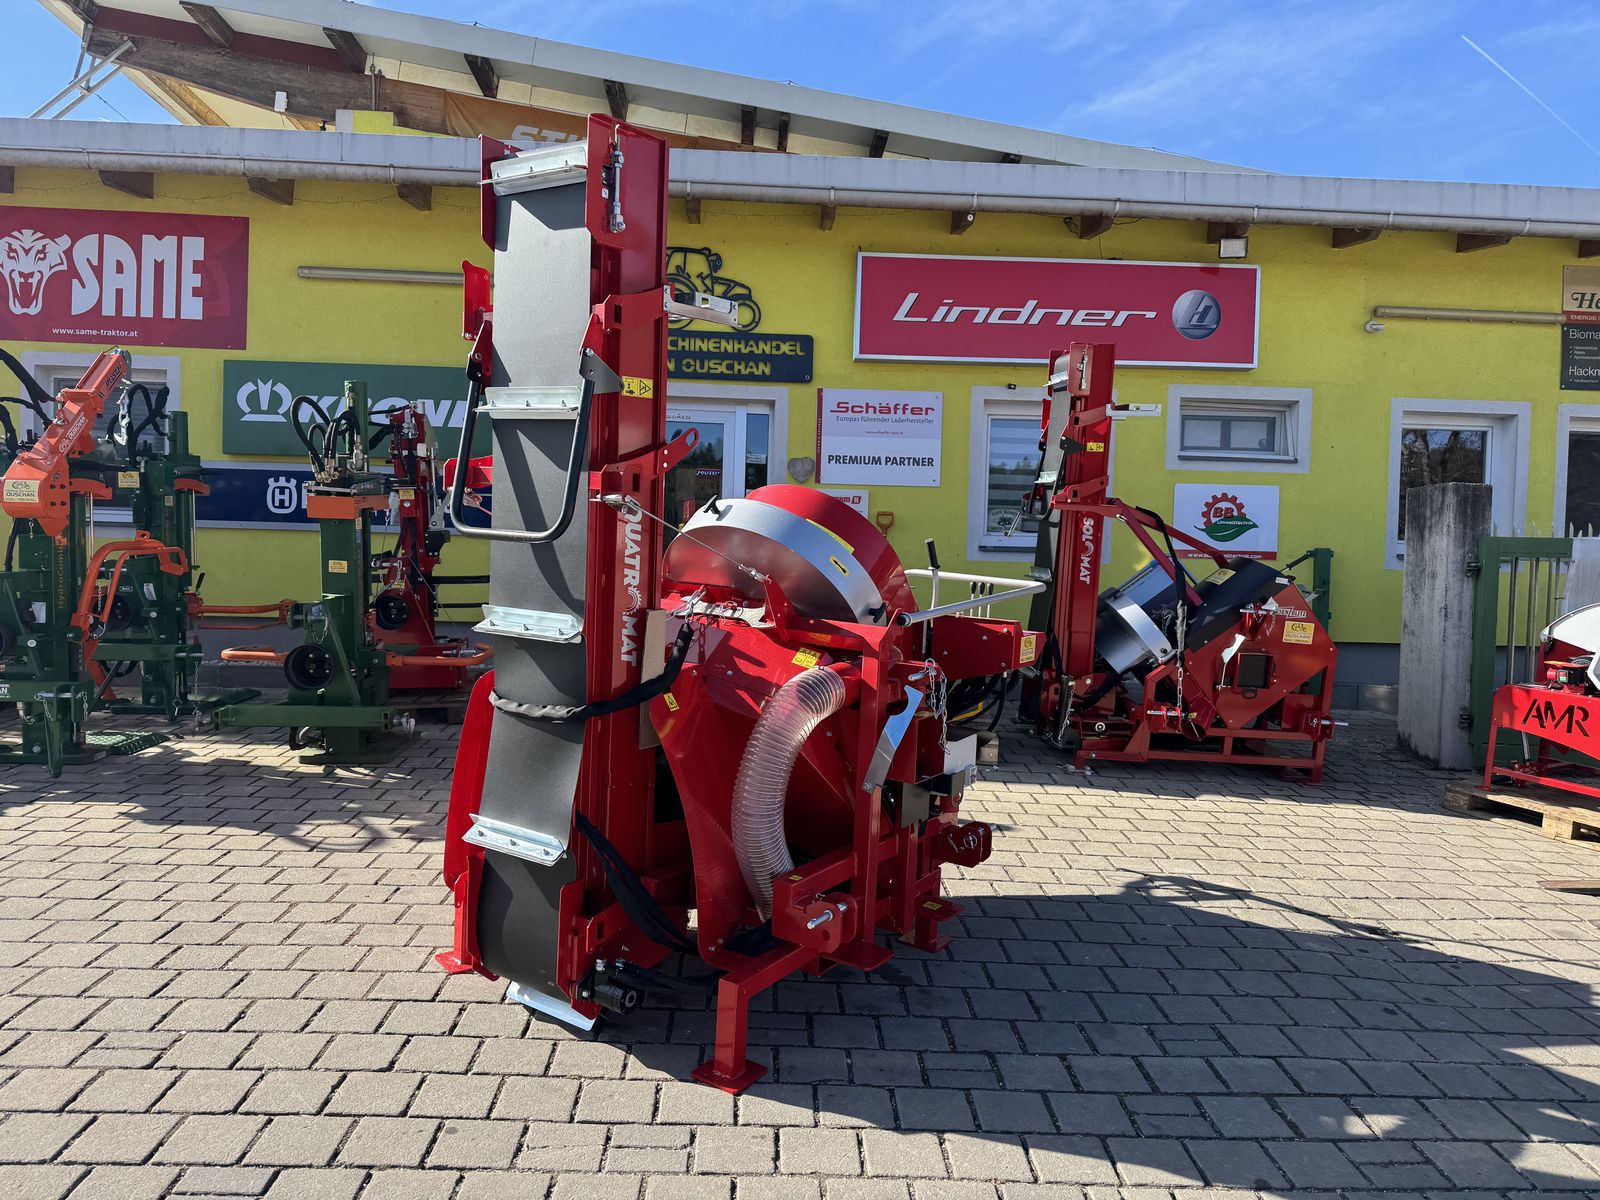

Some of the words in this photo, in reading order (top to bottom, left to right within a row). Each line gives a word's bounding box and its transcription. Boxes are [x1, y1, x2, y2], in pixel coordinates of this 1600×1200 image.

[71, 233, 205, 320] SAME
[892, 292, 1158, 328] Lindner
[52, 327, 138, 337] www.same-traktor.at
[681, 358, 771, 376] OUSCHAN
[830, 401, 935, 416] Schäffer
[836, 415, 859, 423] Europas
[860, 415, 890, 423] führender
[828, 454, 882, 466] PREMIUM
[884, 456, 934, 467] PARTNER
[1213, 506, 1235, 518] BB
[1521, 698, 1591, 738] AMR
